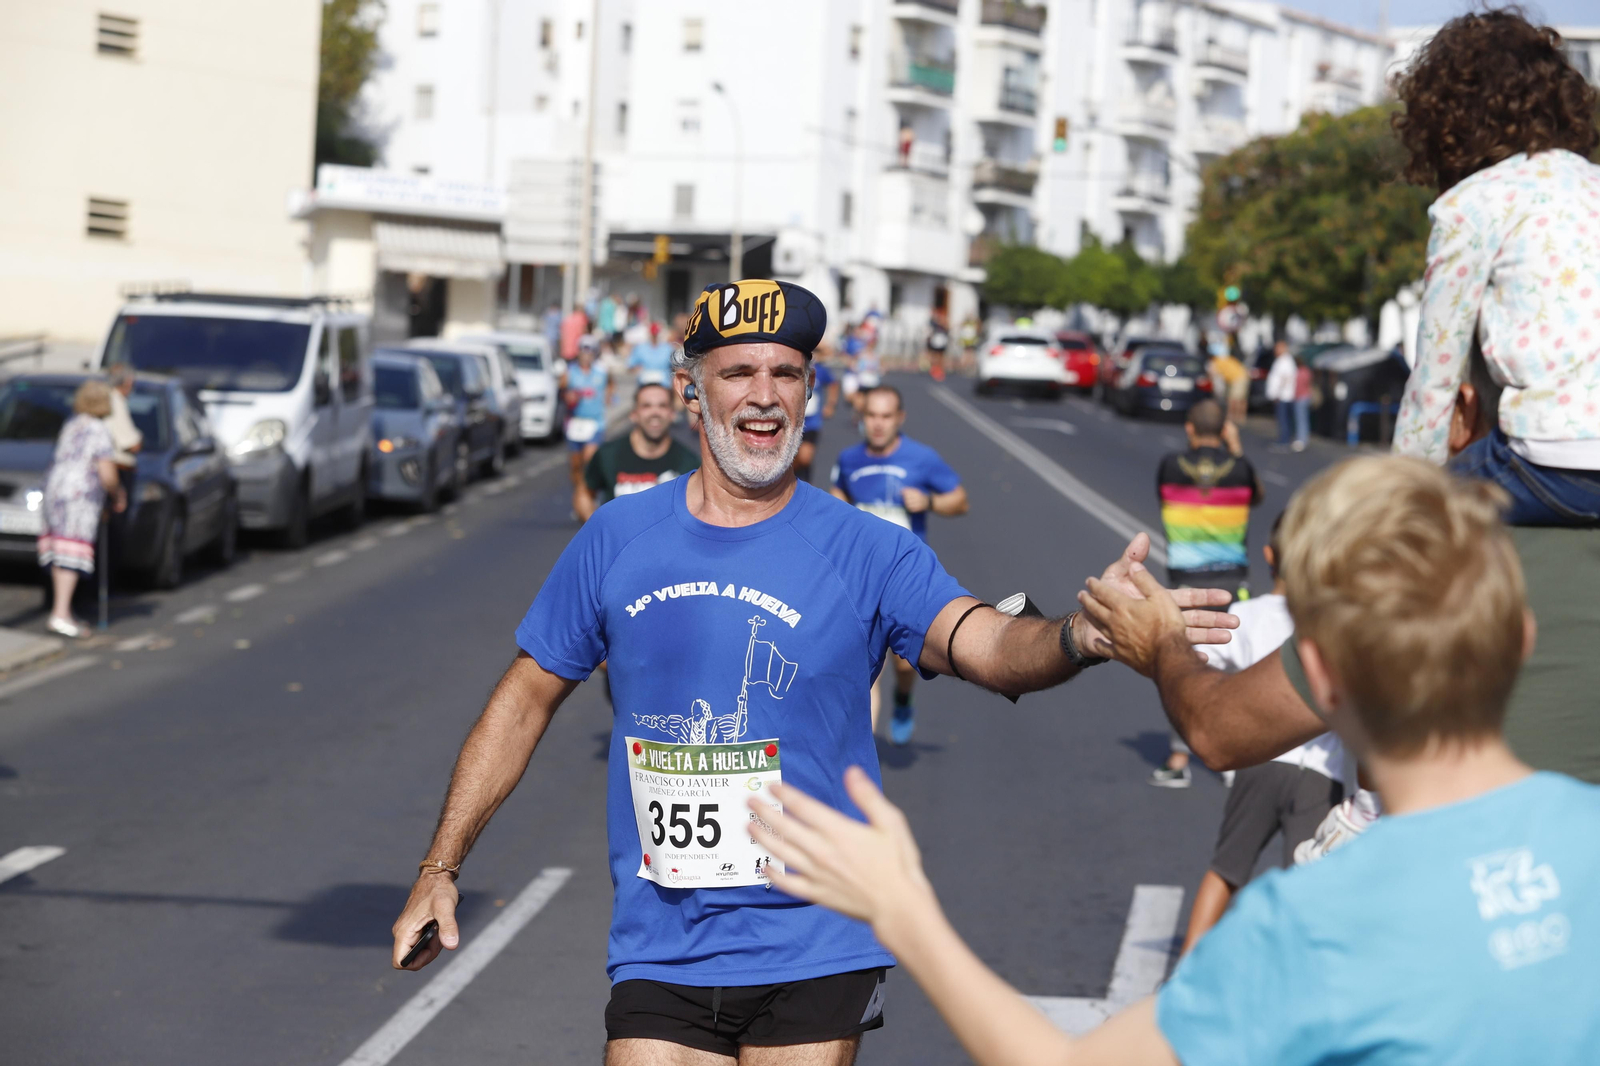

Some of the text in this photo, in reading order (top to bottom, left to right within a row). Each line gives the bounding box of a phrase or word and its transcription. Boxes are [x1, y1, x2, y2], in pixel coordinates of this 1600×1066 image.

[719, 284, 780, 332] BUFF
[653, 581, 719, 602] VUELTA
[721, 584, 736, 599] A
[738, 586, 802, 629] HUELVA
[649, 749, 694, 772] VUELTA
[698, 752, 709, 772] A
[713, 749, 768, 772] HUELVA
[635, 771, 730, 788] FRANCISCO JAVIER
[648, 786, 711, 798] JIMÉNEZ GARCÍA
[648, 800, 722, 849] 355
[664, 852, 720, 860] INDEPENDIENTE
